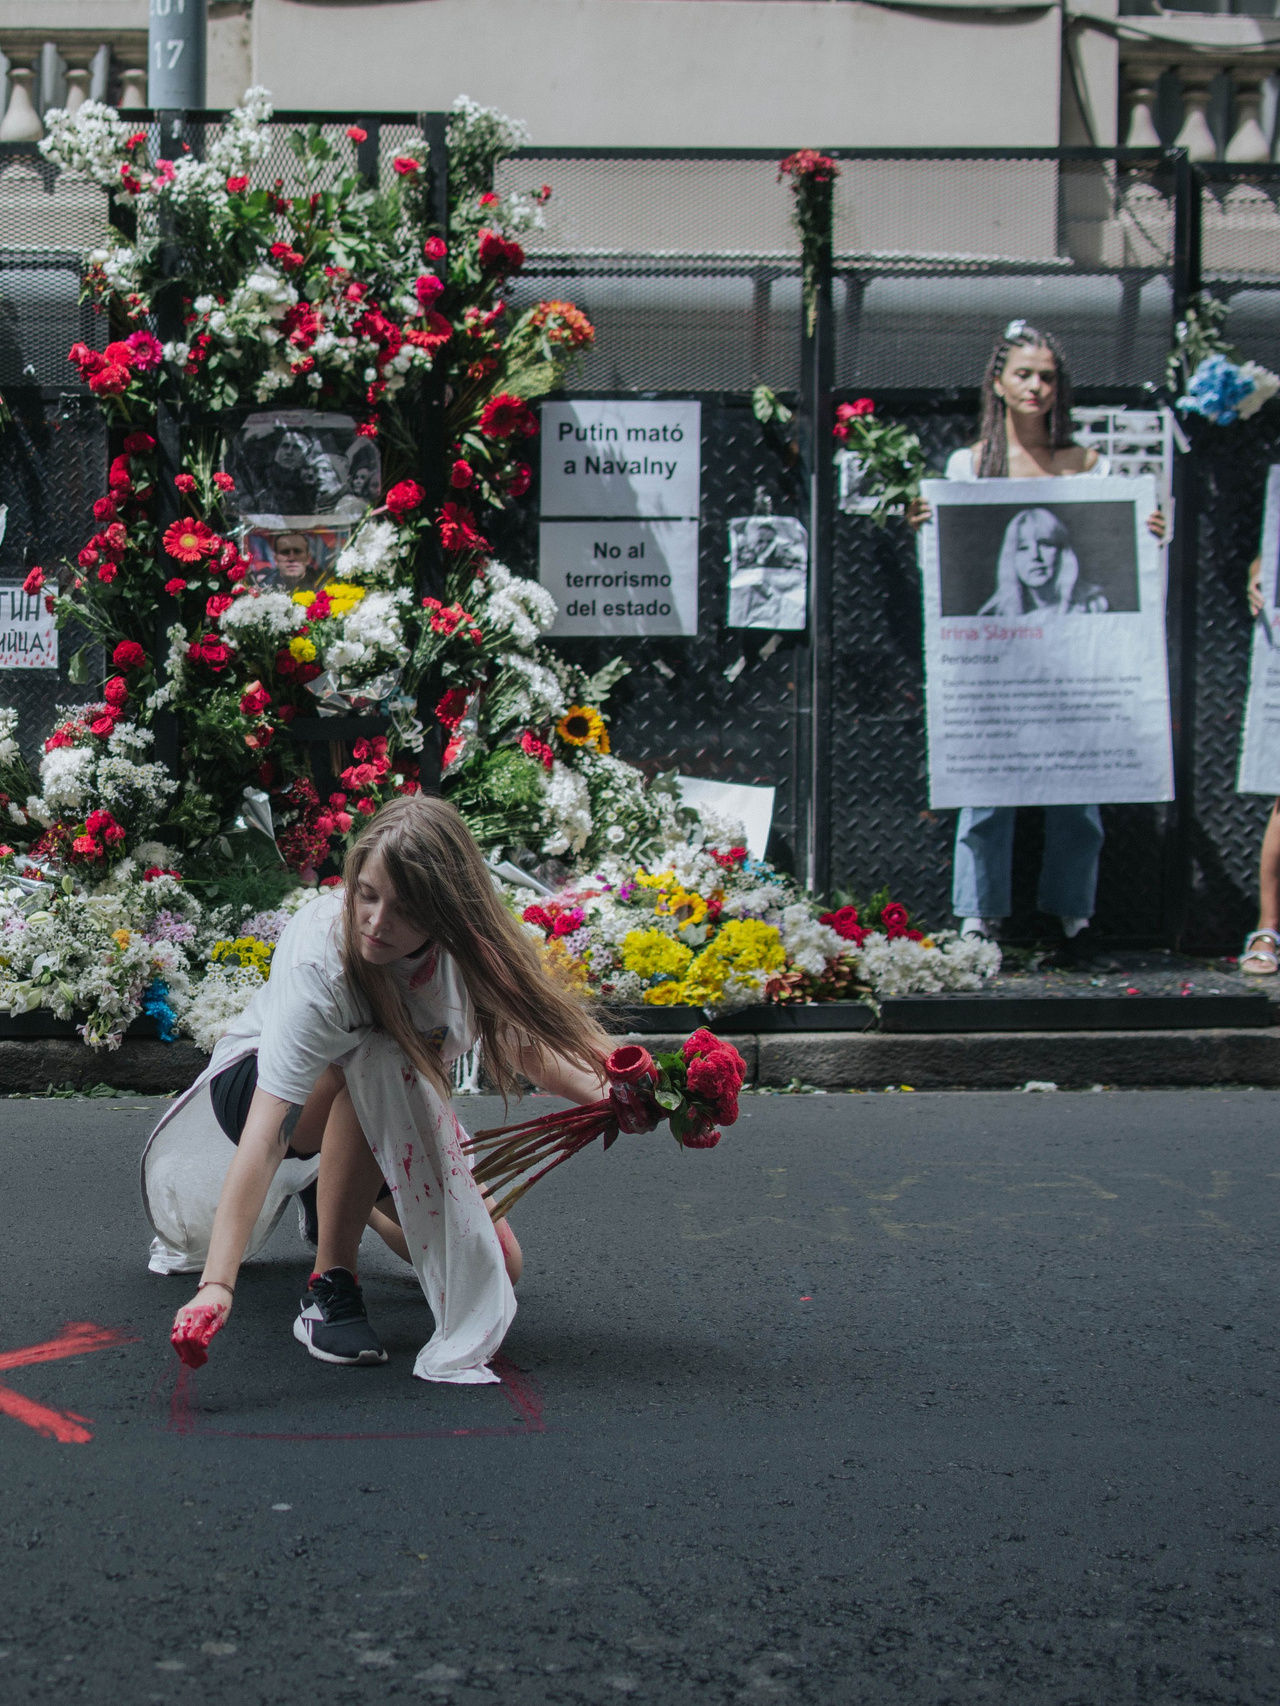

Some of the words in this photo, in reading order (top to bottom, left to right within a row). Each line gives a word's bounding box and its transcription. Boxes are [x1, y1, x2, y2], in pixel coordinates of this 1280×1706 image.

[154, 39, 185, 69] 17
[558, 422, 618, 442] Putin
[627, 423, 684, 442] mató
[564, 461, 576, 475] a
[585, 456, 677, 480] Navalny
[594, 542, 621, 559] No
[628, 542, 645, 559] al
[566, 571, 672, 588] terrorismo
[566, 600, 596, 616] del
[603, 600, 671, 616] estado
